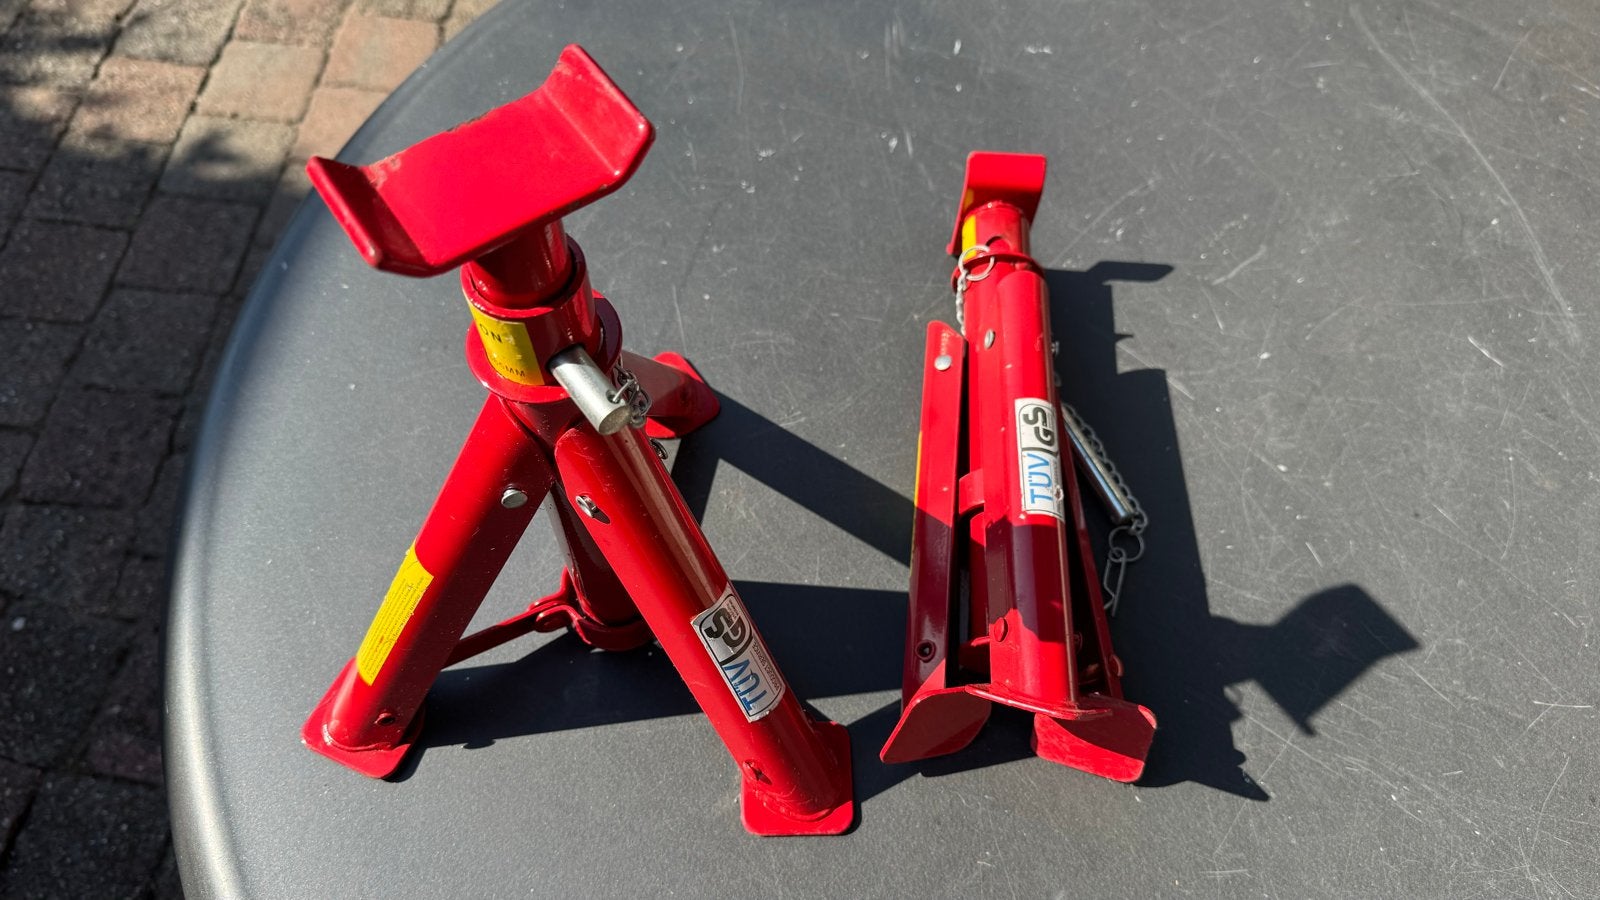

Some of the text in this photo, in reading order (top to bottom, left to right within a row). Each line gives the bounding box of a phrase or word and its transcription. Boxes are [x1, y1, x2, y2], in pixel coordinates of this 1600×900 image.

[1022, 406, 1055, 504] TÜV GS
[704, 607, 768, 711] TÜV GS
